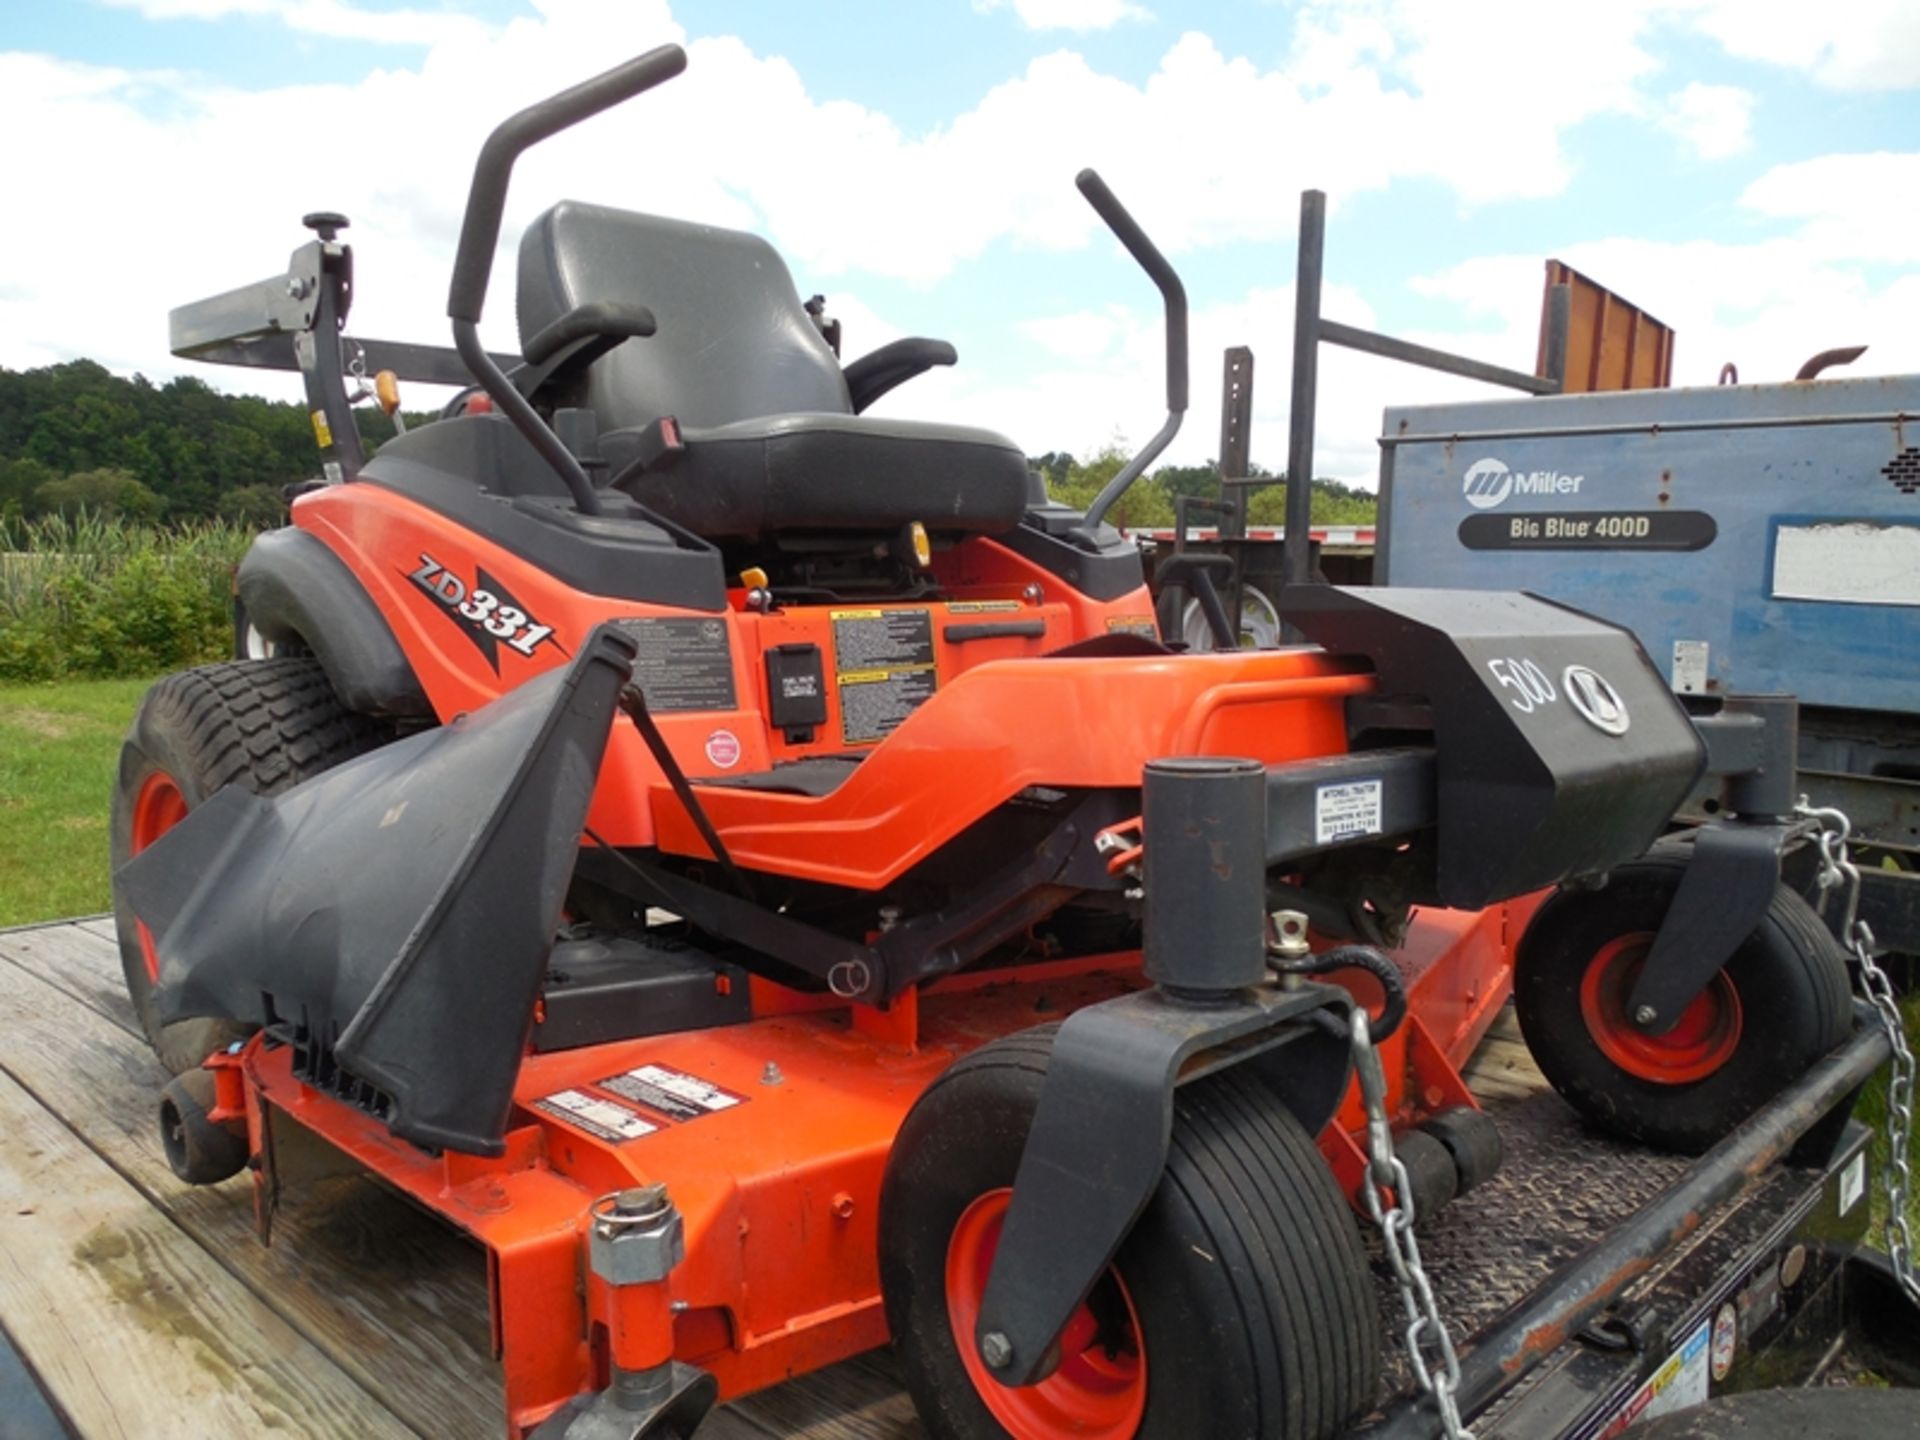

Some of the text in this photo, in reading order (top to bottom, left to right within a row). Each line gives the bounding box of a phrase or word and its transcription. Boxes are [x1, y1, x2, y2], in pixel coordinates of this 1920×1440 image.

[1515, 472, 1583, 494] Miller
[1510, 517, 1650, 538] Big Blue 400D
[410, 554, 553, 655] ZD331
[1488, 658, 1556, 713] 500
